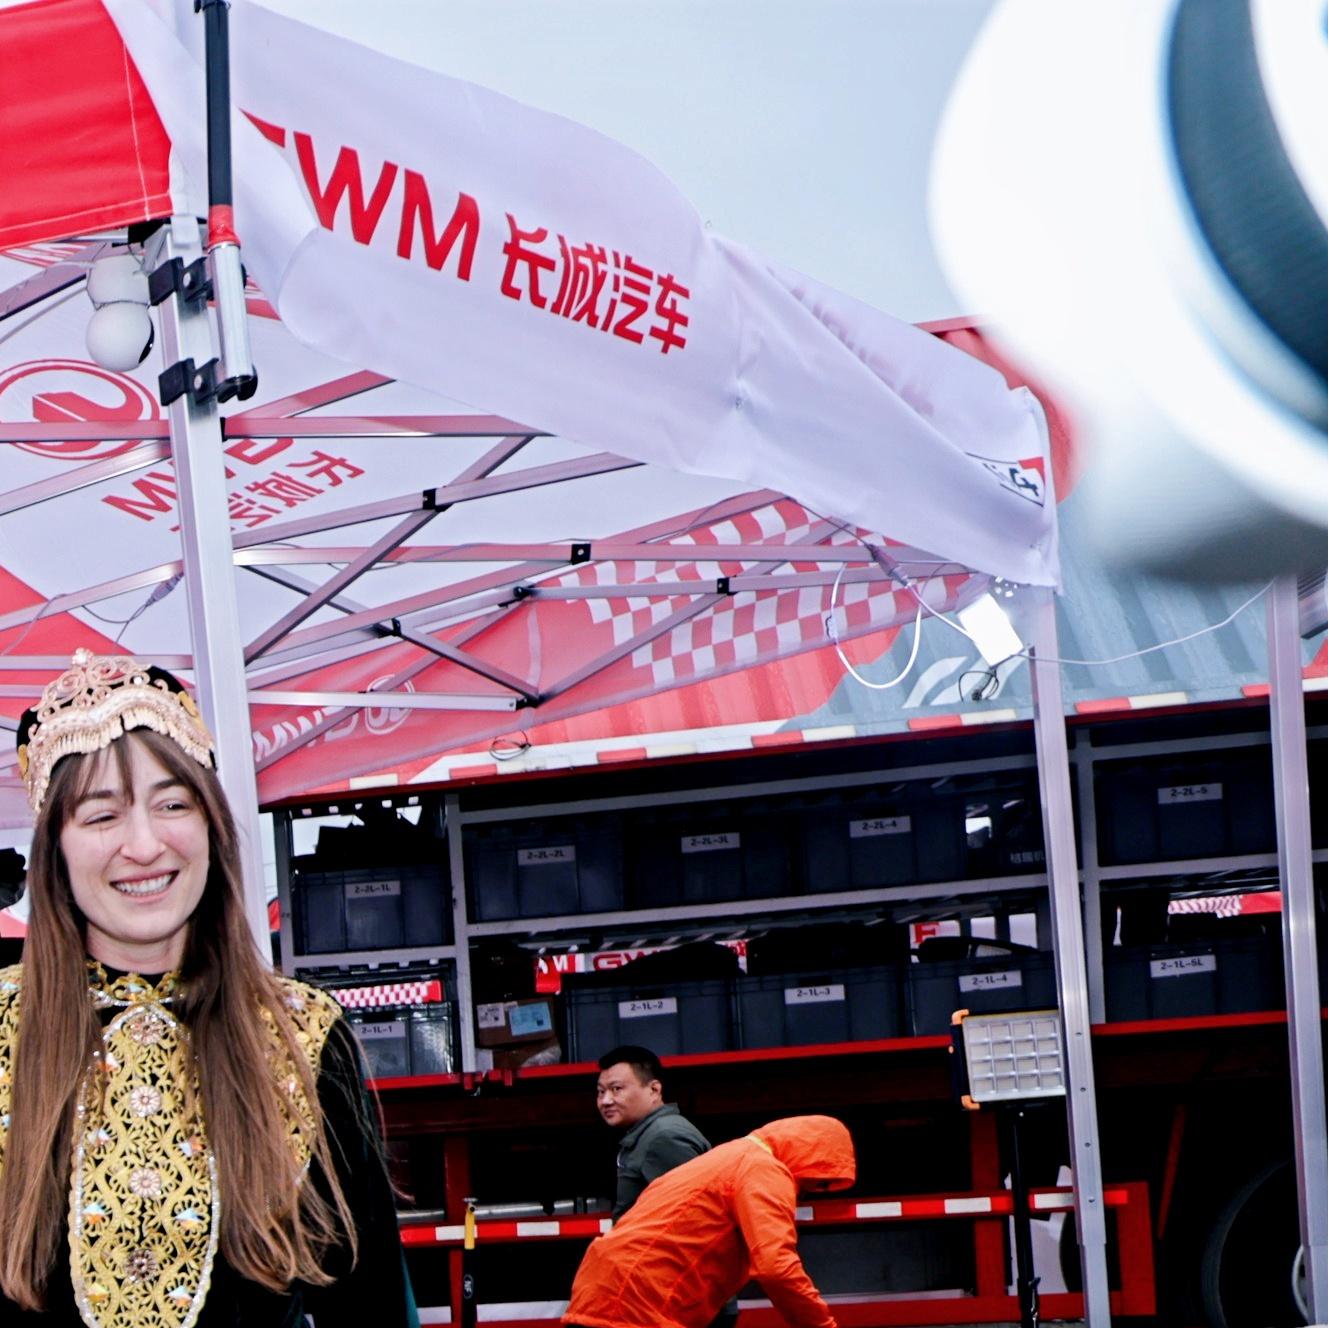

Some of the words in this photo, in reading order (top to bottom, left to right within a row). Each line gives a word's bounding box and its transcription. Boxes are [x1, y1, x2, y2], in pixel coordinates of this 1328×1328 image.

[239, 107, 481, 282] WM
[502, 212, 691, 355] 长城汽车
[972, 974, 1007, 986] 2-1L-4
[796, 987, 831, 998] 2-1L-3
[630, 1000, 664, 1012] 2-1L-2
[361, 1025, 393, 1034] 2-1L-1
